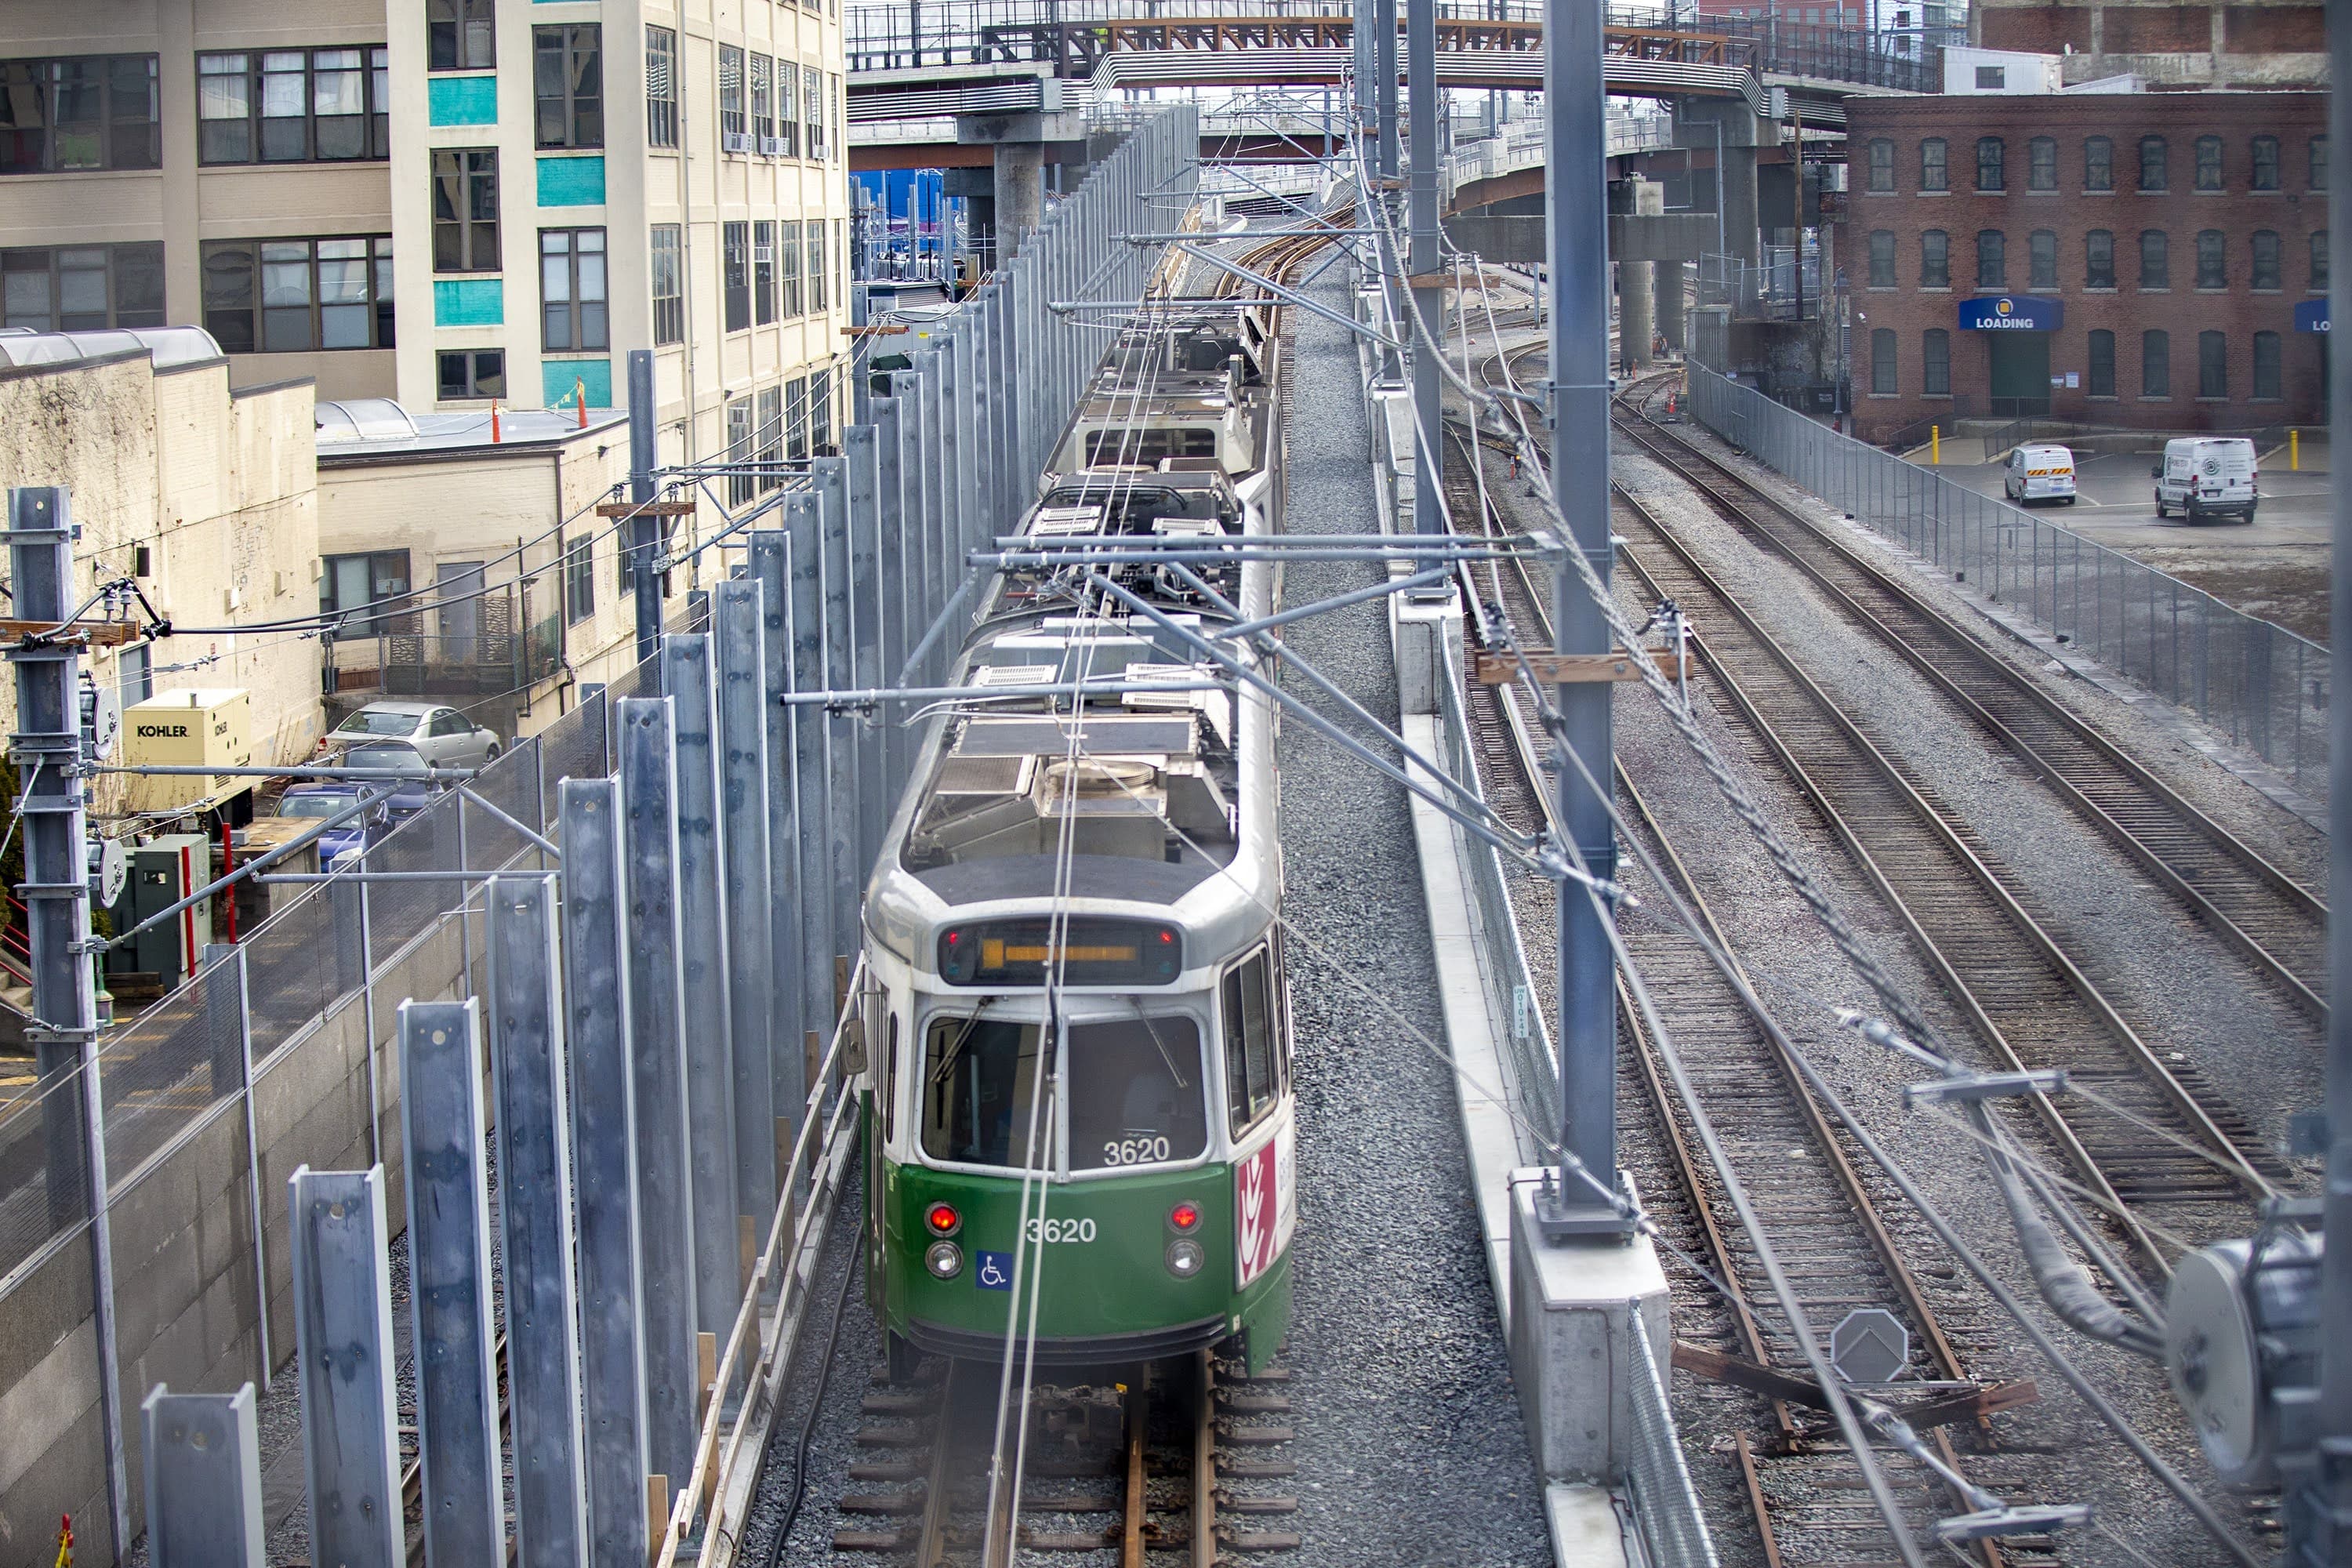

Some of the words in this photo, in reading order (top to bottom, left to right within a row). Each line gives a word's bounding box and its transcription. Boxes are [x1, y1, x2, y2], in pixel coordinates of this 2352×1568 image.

[1976, 318, 2034, 328] LOADING
[136, 725, 188, 738] KOHLER
[1103, 1136, 1170, 1167] 3620
[1025, 1218, 1097, 1243] 3620
